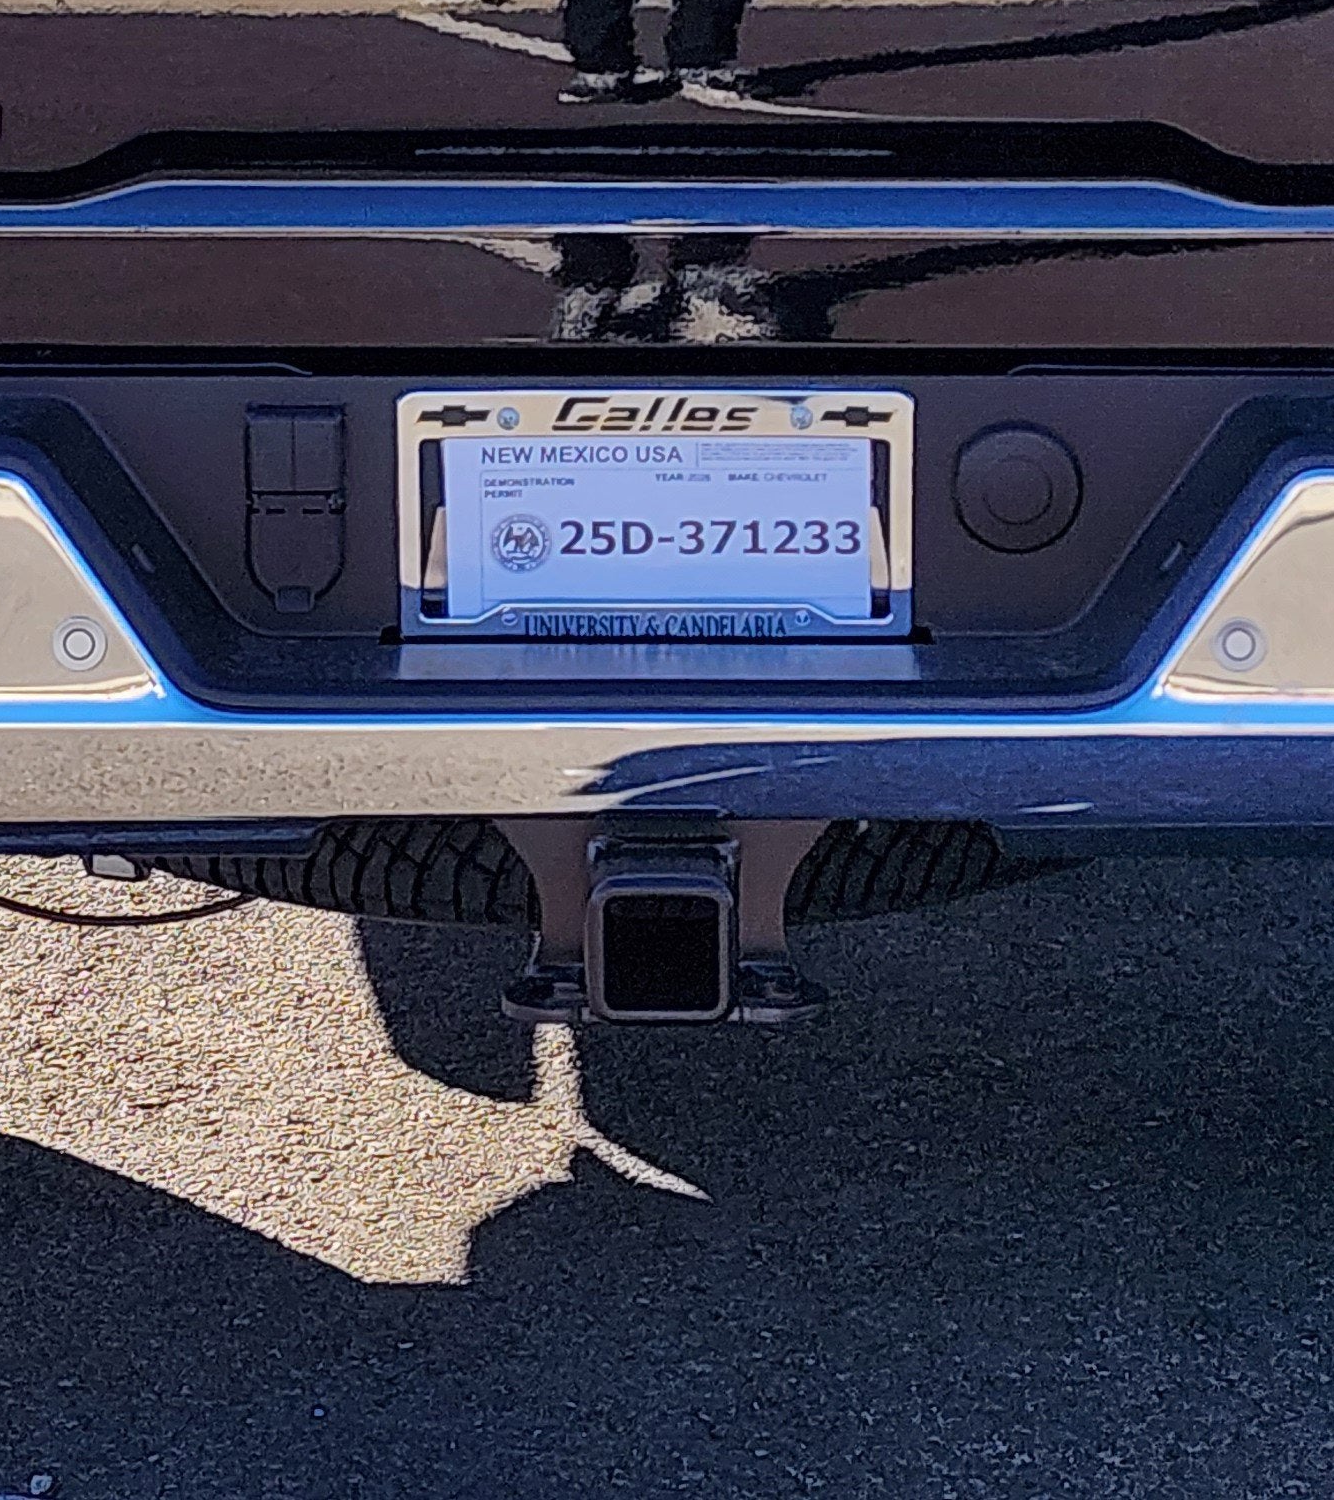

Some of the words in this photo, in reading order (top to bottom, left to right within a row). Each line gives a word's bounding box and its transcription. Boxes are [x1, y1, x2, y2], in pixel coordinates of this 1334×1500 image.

[552, 397, 759, 431] Galles
[481, 446, 534, 464] NEW
[540, 446, 628, 464] MEXICO
[636, 445, 683, 463] USA
[484, 478, 575, 487] DEMONSTRATION
[655, 473, 683, 482] YEAR
[560, 520, 861, 555] 25D-371233
[524, 612, 640, 637] UNIVERSITY
[644, 614, 661, 637] &
[666, 611, 787, 637] CANDELARIA
